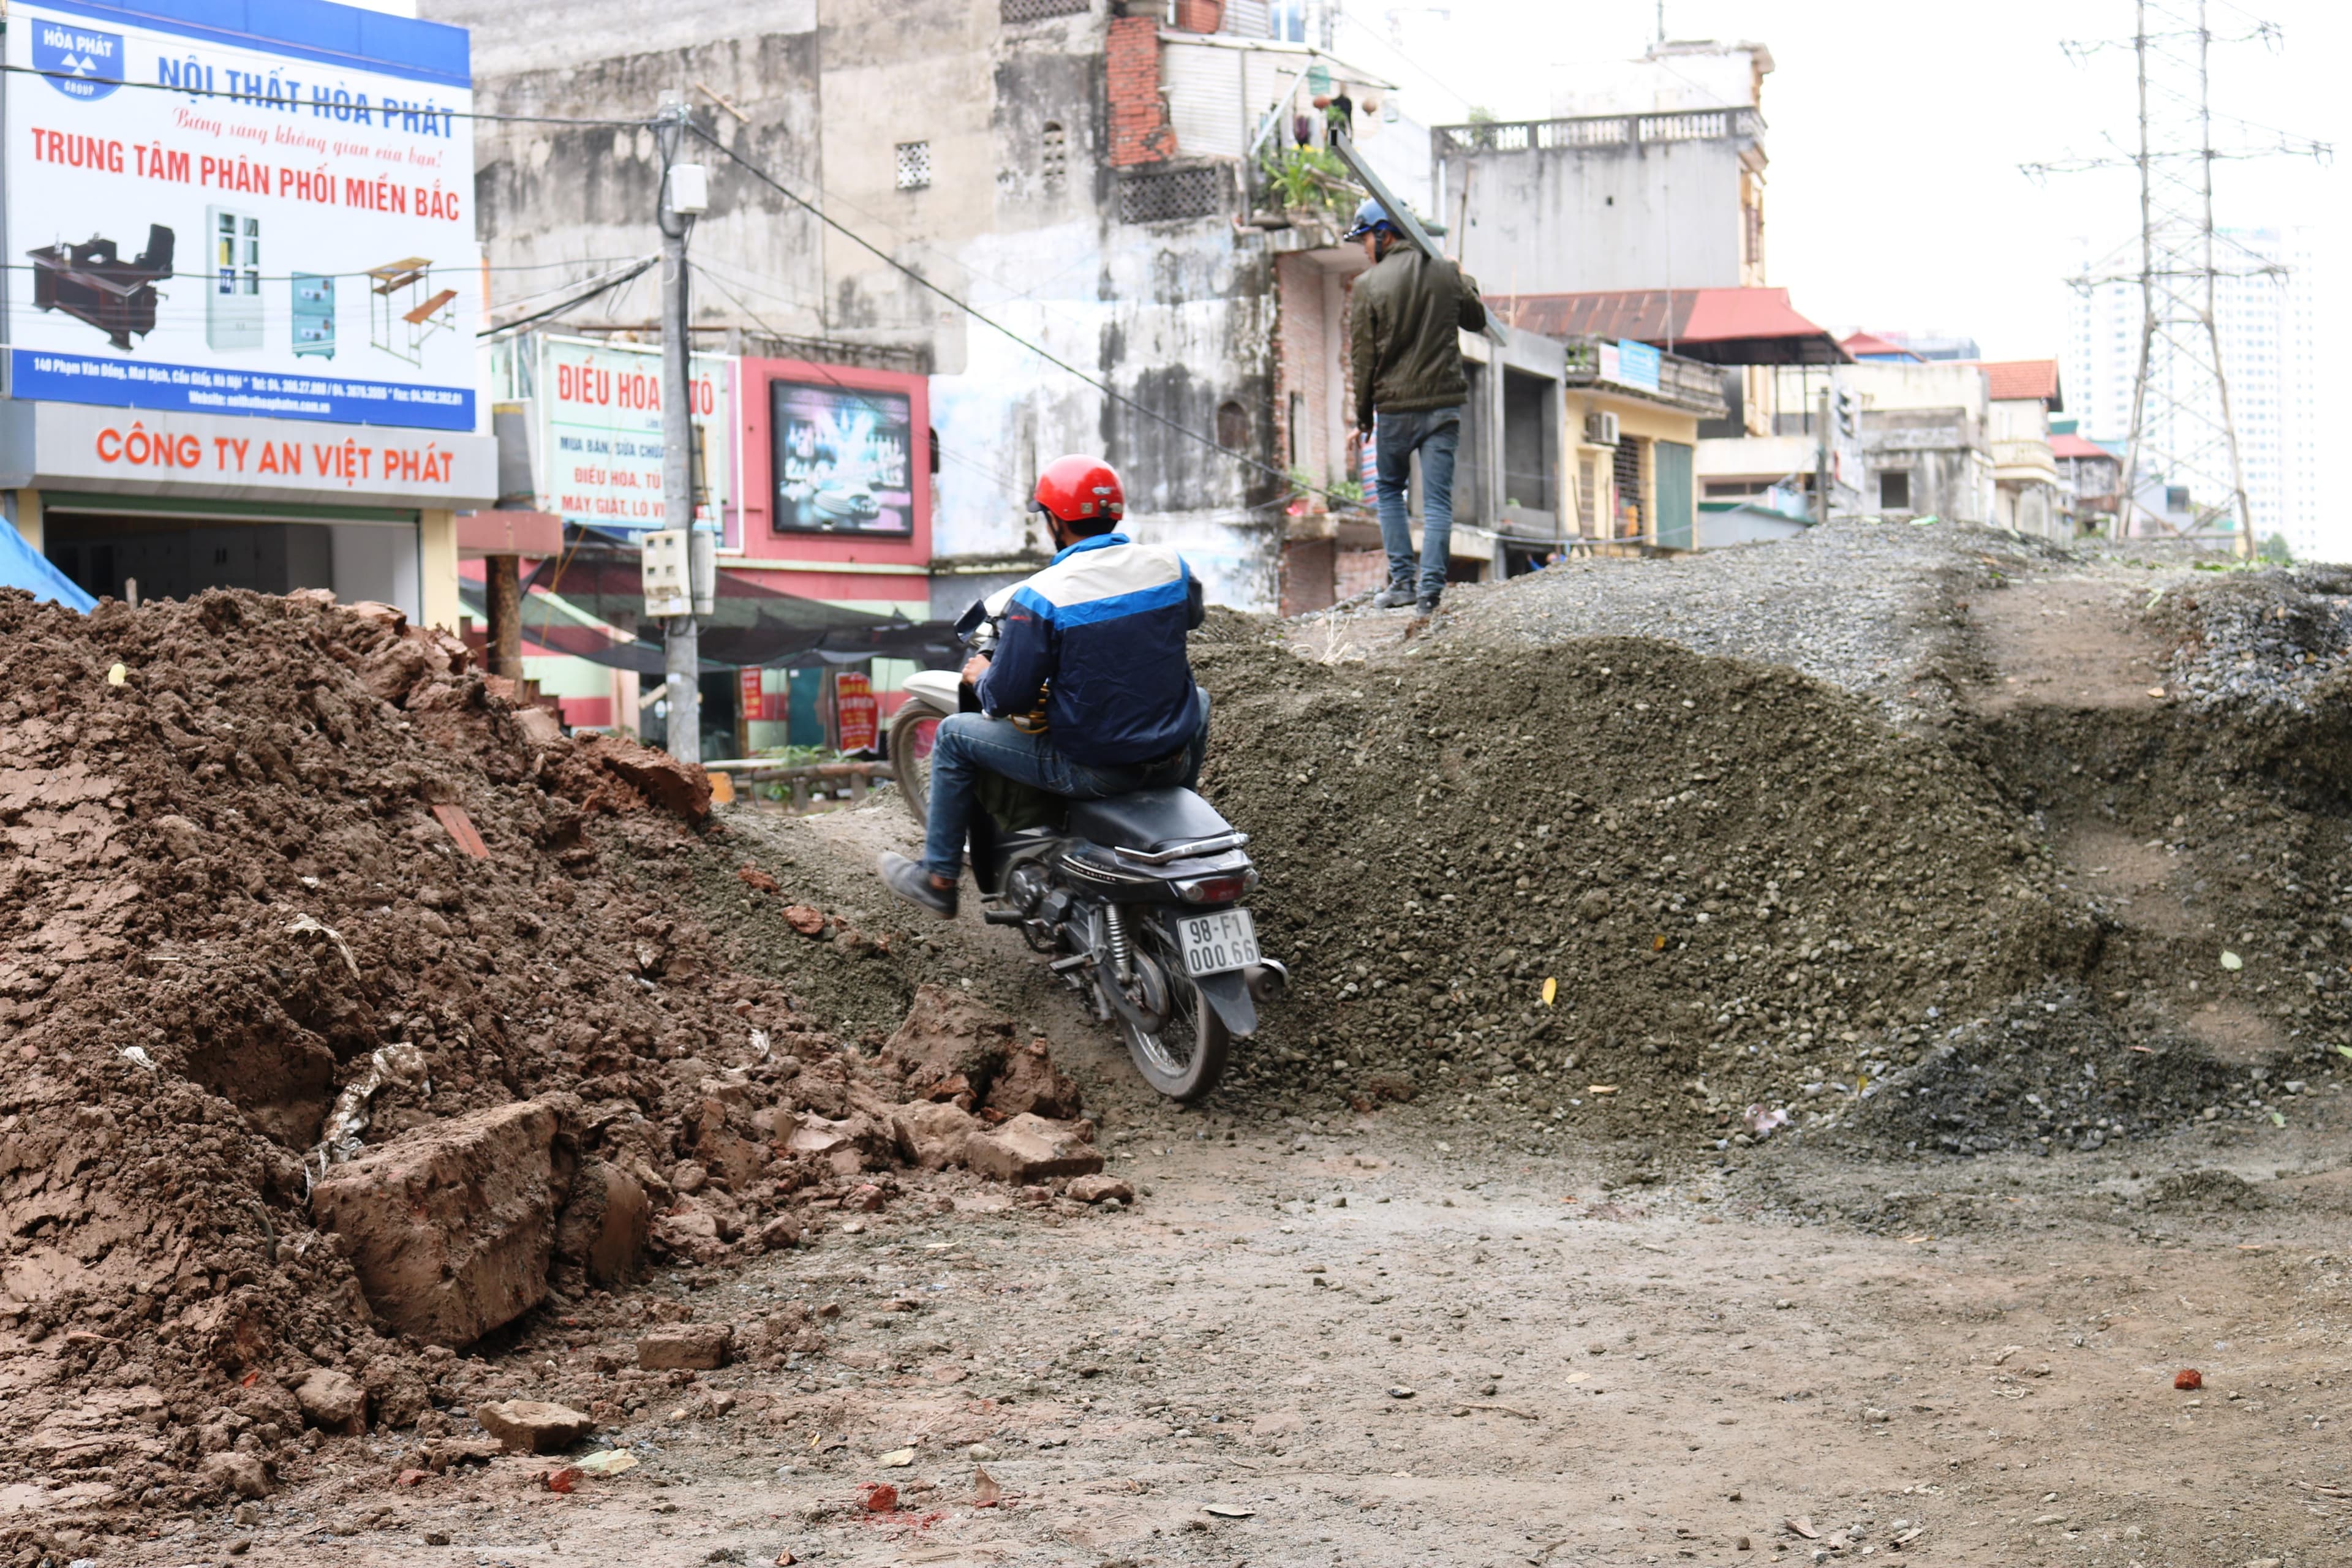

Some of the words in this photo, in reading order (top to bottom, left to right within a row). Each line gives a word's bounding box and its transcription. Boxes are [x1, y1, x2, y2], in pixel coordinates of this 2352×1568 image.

[75, 34, 113, 58] PHÁT
[158, 54, 213, 104] NỘI
[225, 67, 301, 113] THẤT
[312, 80, 372, 126] HÒA
[382, 98, 454, 138] PHÁT
[31, 127, 124, 174] TRUNG
[133, 140, 190, 184] TÂM
[200, 153, 270, 196] PHÂN
[279, 162, 336, 205] PHỐI
[415, 178, 459, 221] BẮC
[617, 363, 661, 412] HÒA
[96, 420, 202, 469] CÔNG
[214, 437, 250, 472] TY
[257, 440, 301, 475] AN
[313, 436, 372, 488] VIỆT
[383, 442, 454, 483] PHÁT
[1189, 913, 1243, 944] 98-F1
[1189, 939, 1256, 972] 000.66
